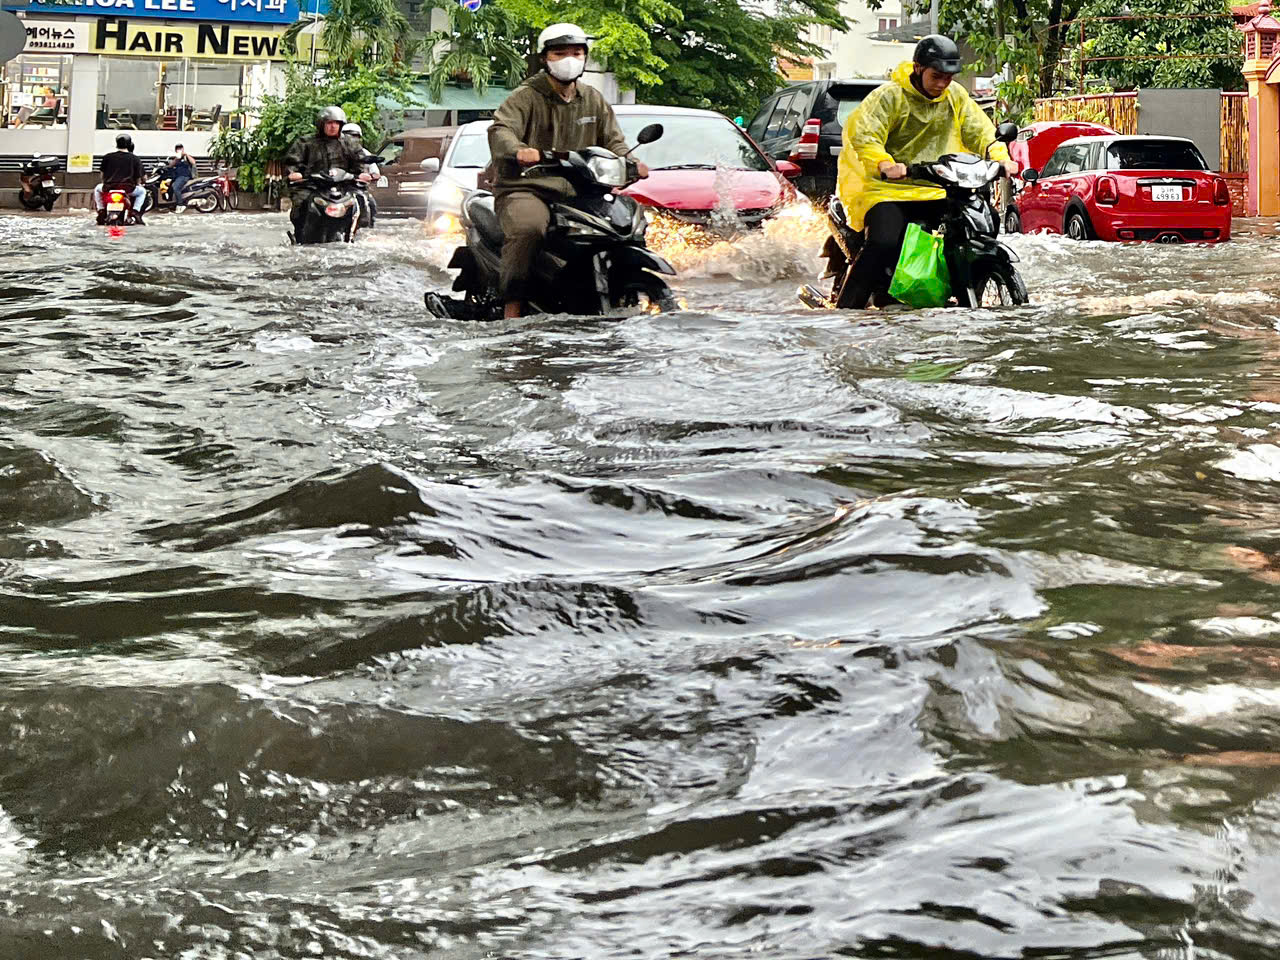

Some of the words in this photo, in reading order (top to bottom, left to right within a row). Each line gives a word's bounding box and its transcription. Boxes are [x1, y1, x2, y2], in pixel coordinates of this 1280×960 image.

[25, 26, 75, 40] 헤어뉴스
[95, 19, 184, 53] HAIR
[197, 24, 286, 57] NEW
